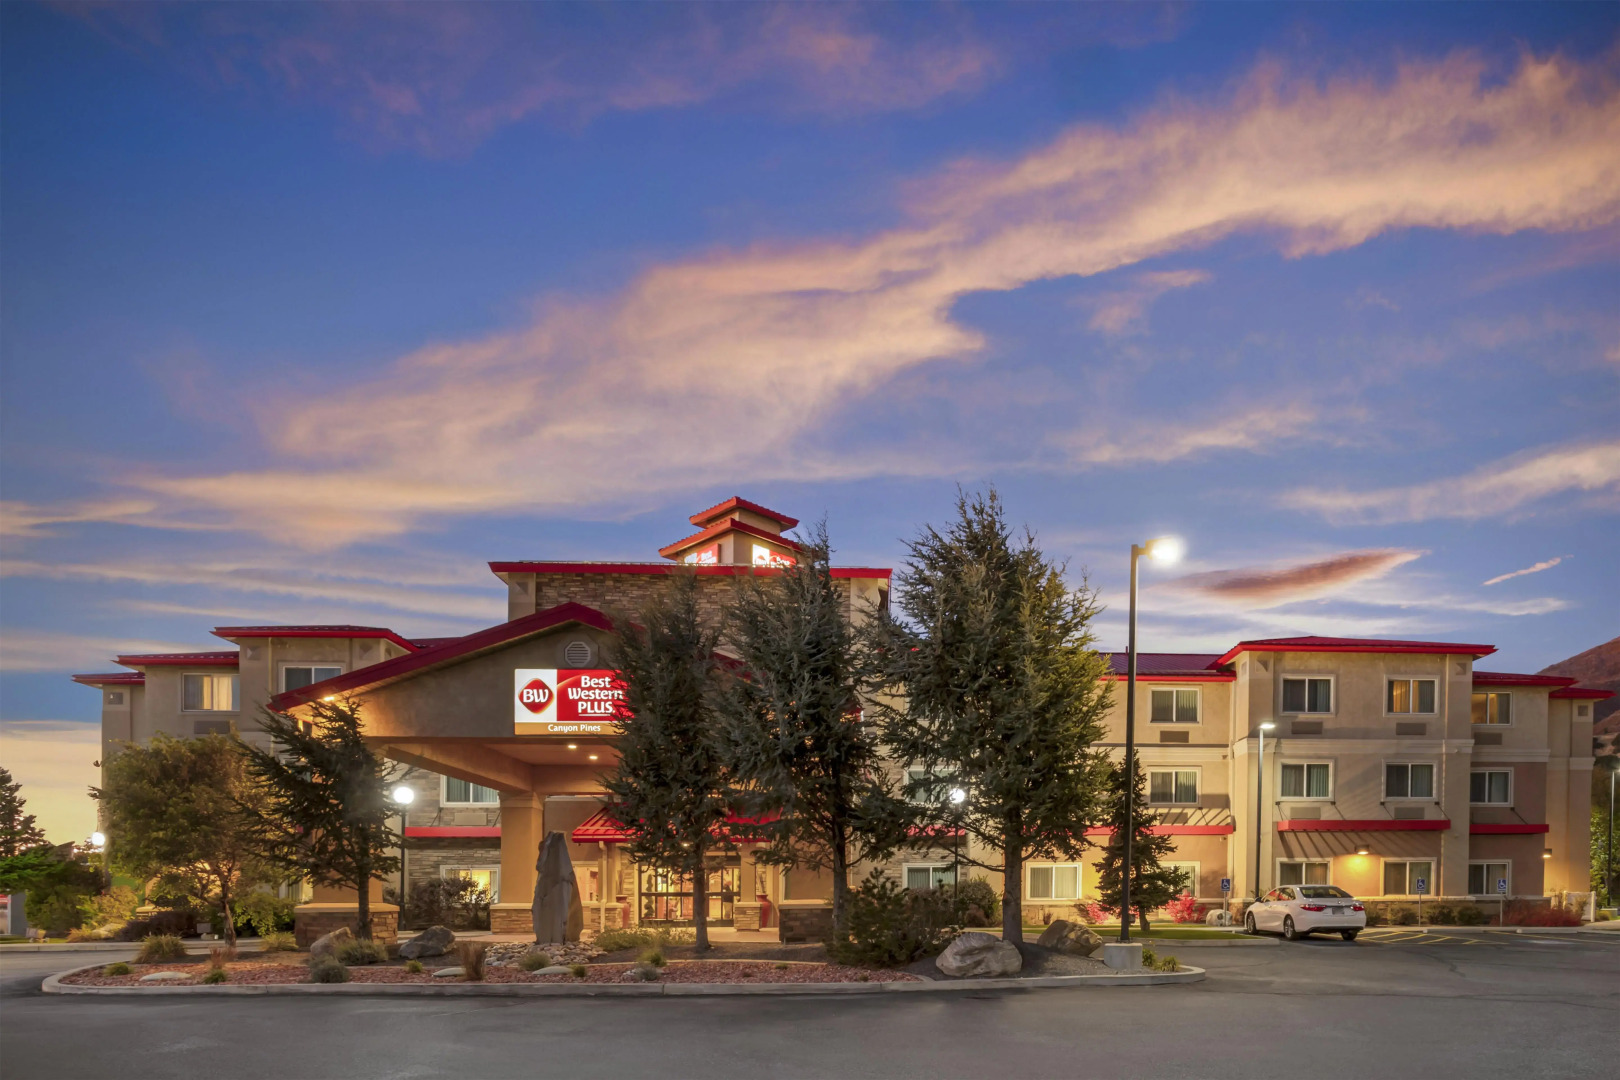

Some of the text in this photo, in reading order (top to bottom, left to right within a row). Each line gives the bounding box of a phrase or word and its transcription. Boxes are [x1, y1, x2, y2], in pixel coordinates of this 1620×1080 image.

[581, 675, 611, 687] Best
[523, 689, 549, 702] BW
[568, 688, 623, 699] Western
[548, 724, 578, 733] Canyon
